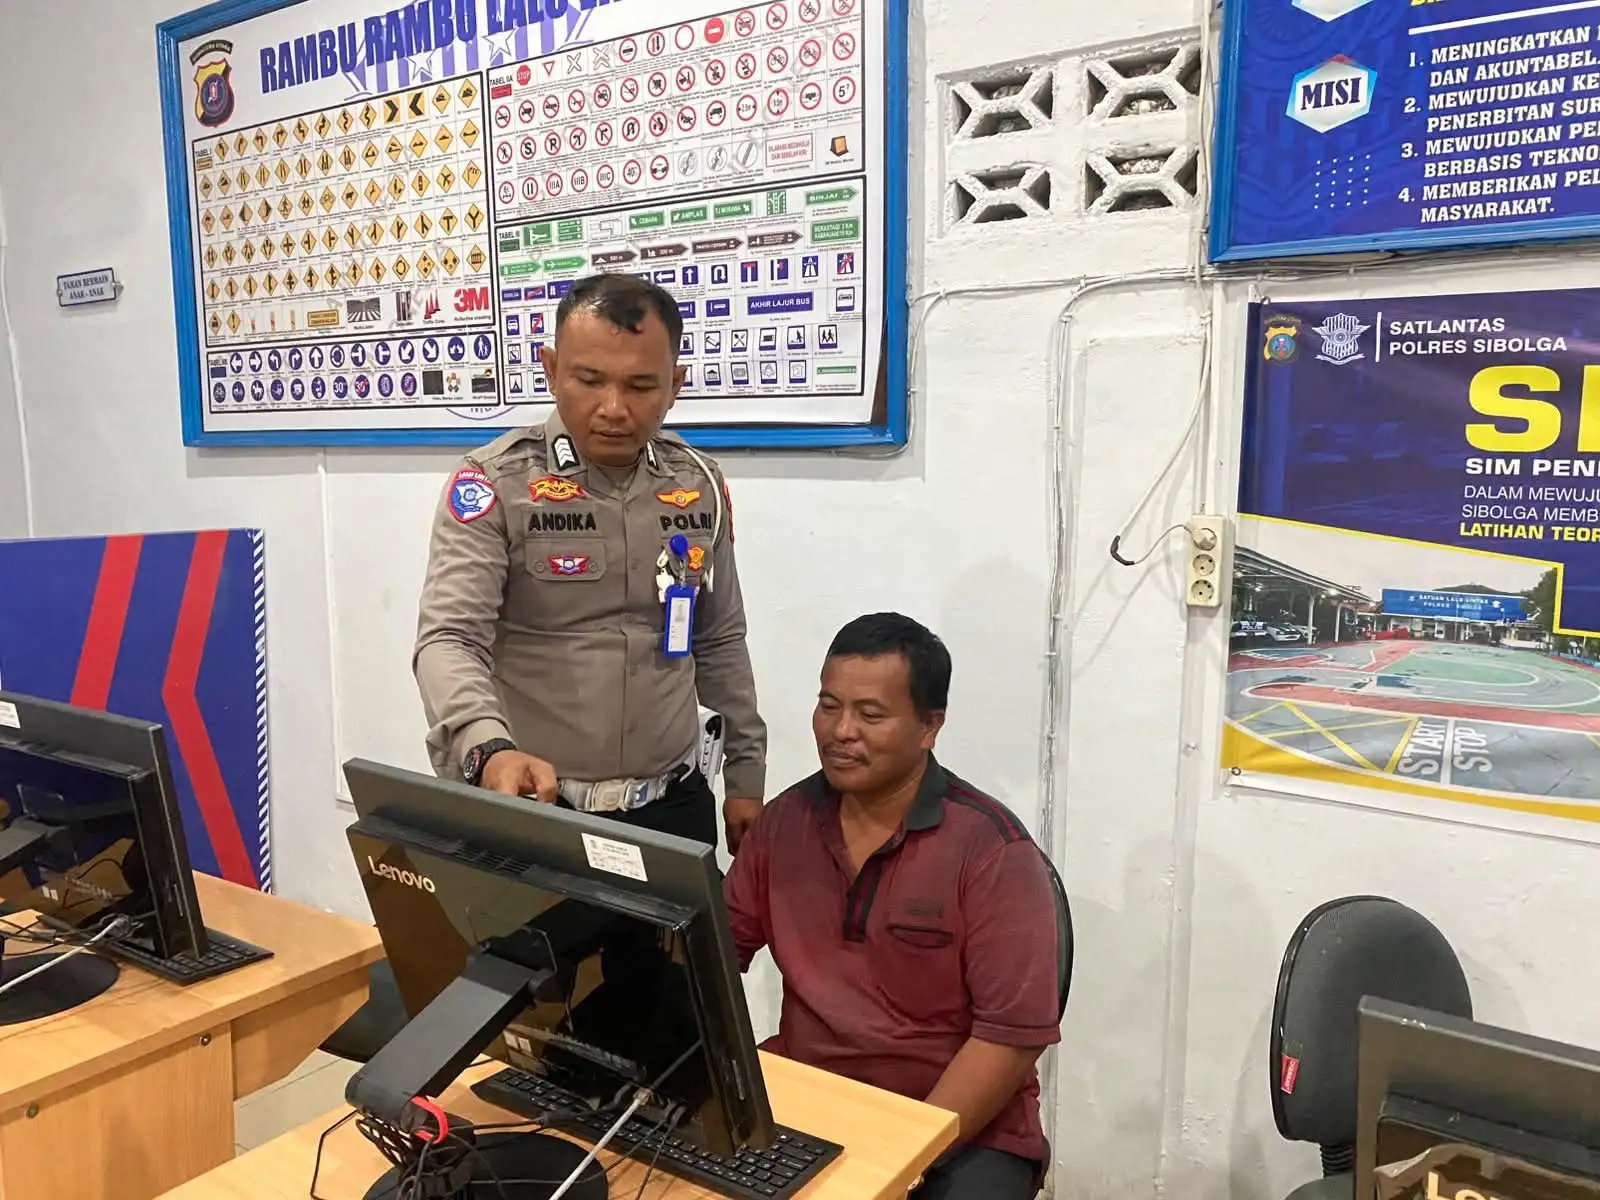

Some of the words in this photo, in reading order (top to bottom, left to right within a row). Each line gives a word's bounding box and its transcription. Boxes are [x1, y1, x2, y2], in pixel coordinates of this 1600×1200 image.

[260, 22, 357, 94] RAMBU
[364, 0, 478, 66] RAMBU
[1409, 52, 1424, 67] 1.
[1431, 26, 1591, 64] MENINGKATKAN
[490, 76, 505, 86] TABEL
[516, 71, 531, 81] STOP
[1430, 67, 1469, 87] DAN
[1300, 77, 1362, 111] MISI
[1404, 97, 1421, 113] 2.
[1428, 78, 1567, 110] MEWUJUDKAN
[1427, 103, 1555, 133] PENERBITAN
[525, 142, 532, 155] S
[550, 138, 557, 150] R
[1401, 143, 1418, 158] 3.
[1425, 125, 1562, 156] MEWUJUDKAN
[1424, 153, 1522, 178] BERBASIS
[1398, 188, 1415, 202] 4.
[1423, 173, 1557, 200] MEMBERIKAN
[1421, 197, 1555, 223] MASYARAKAT.
[454, 286, 490, 313] 3M
[751, 300, 771, 308] AKHIR
[773, 299, 794, 307] LAJUR
[795, 297, 810, 305] BUS
[1389, 318, 1505, 336] SATLANTAS
[1389, 339, 1467, 355] POLRES
[1473, 337, 1567, 353] SIBOLGA
[1466, 458, 1520, 475] SIM
[1464, 485, 1523, 499] DALAM
[528, 512, 597, 531] ANDIKA
[1462, 504, 1538, 520] SIBOLGA
[1460, 522, 1543, 539] LATIHAN
[1397, 723, 1446, 775] START
[1453, 727, 1493, 772] STOP
[368, 855, 436, 893] Lenovo
